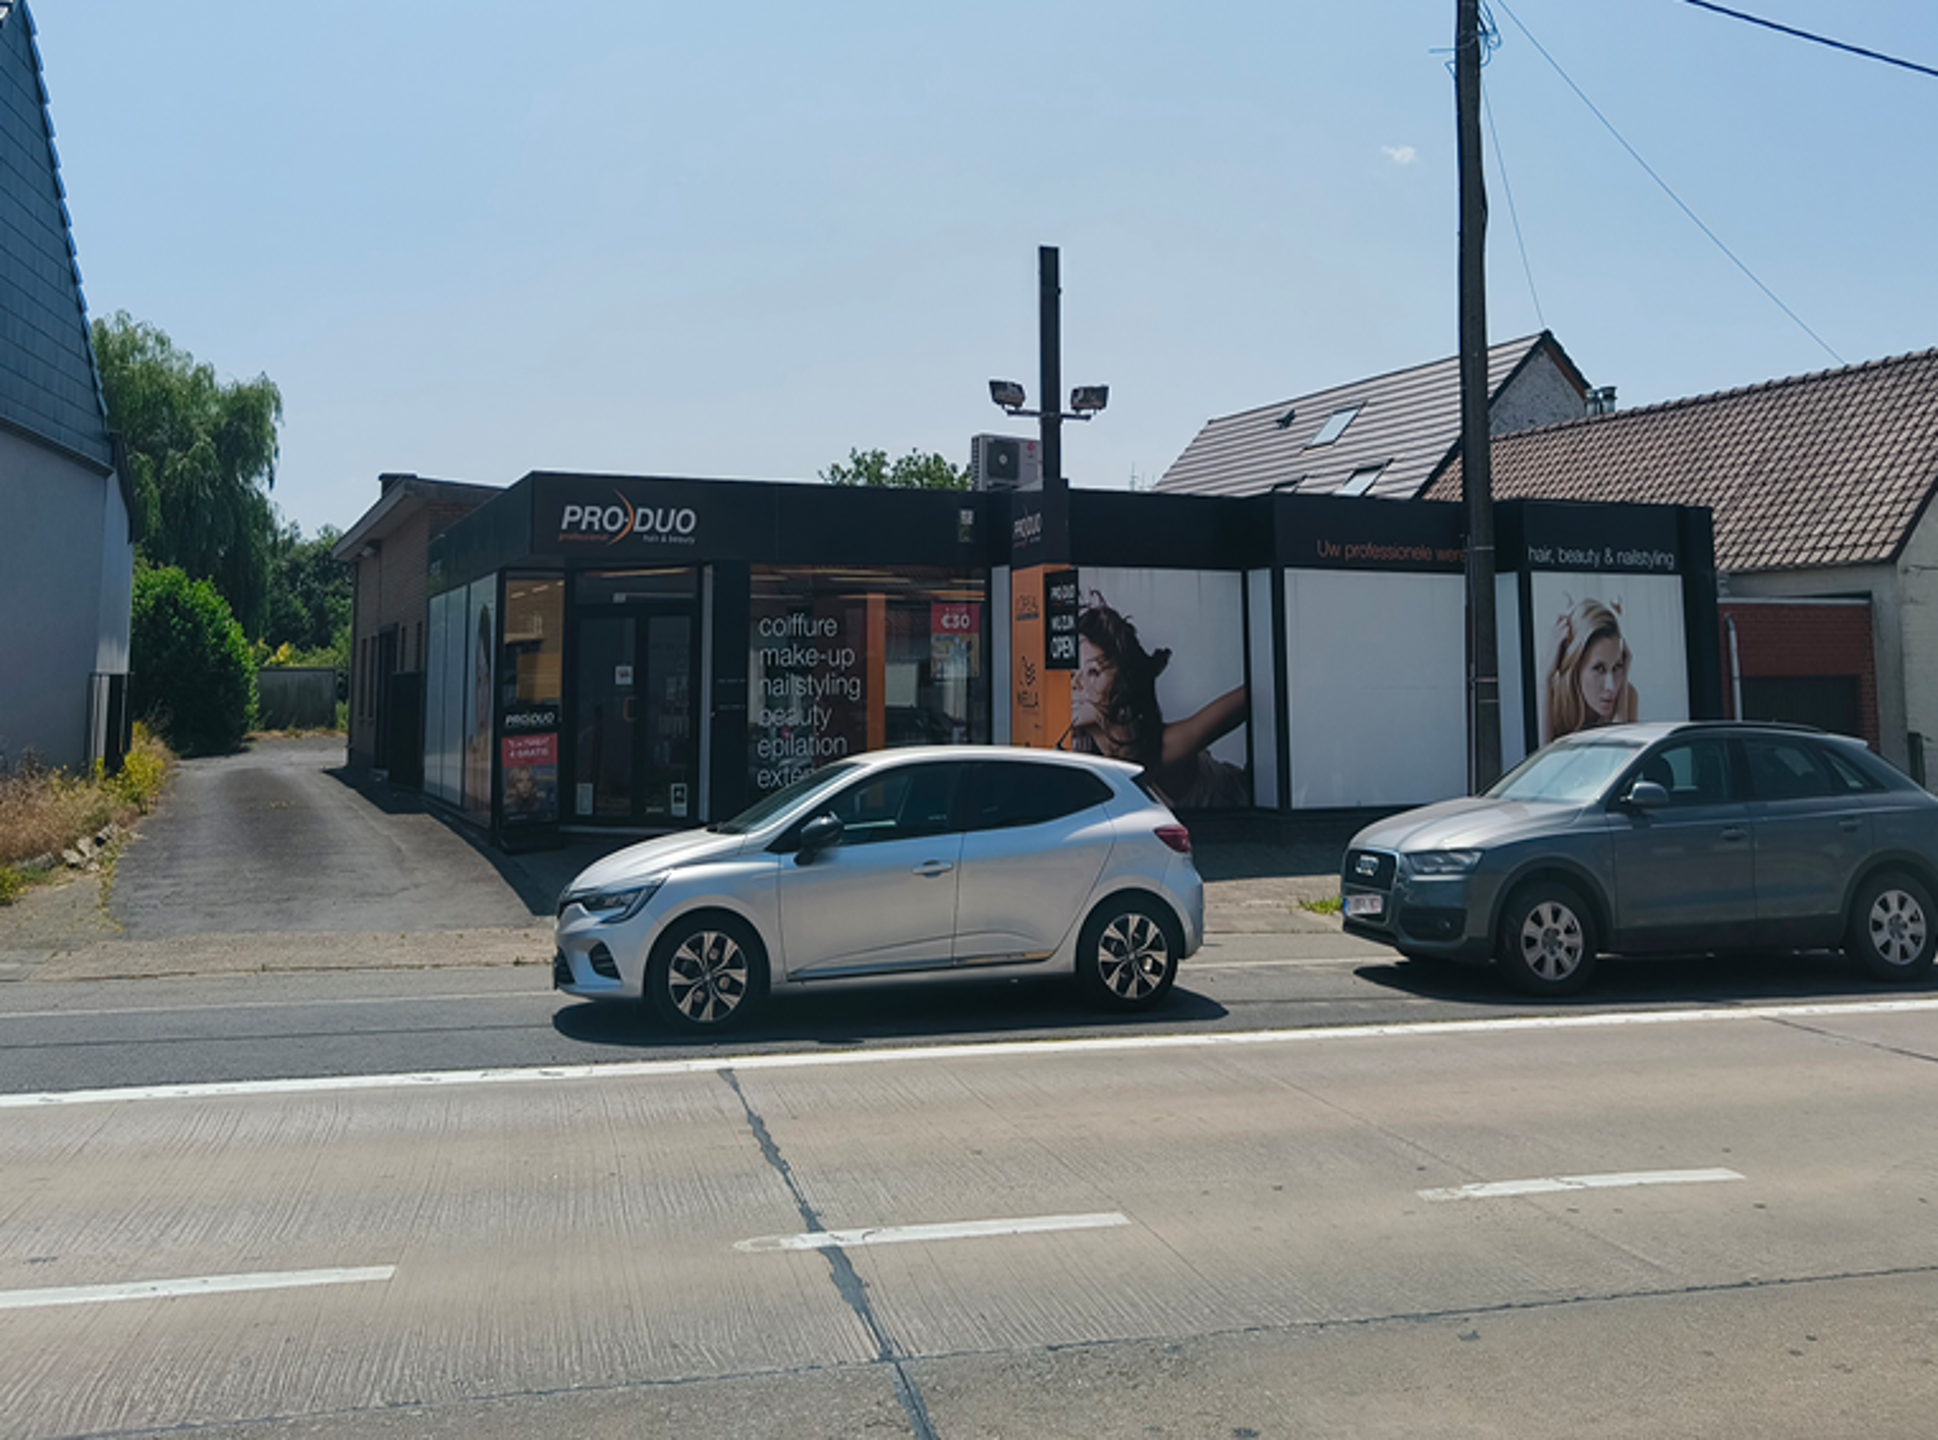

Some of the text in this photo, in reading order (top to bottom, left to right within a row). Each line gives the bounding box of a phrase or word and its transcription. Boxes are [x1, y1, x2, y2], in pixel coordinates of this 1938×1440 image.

[1316, 539, 1341, 558] Uw
[1345, 542, 1433, 561] professionele
[1527, 545, 1675, 570] hair, beauty & nailstyling
[758, 613, 838, 638] coiffure
[758, 643, 855, 670] make-up
[1050, 635, 1077, 660] OPEN
[758, 672, 861, 700] nailstyling
[757, 703, 832, 731] beauty
[757, 733, 848, 760] epilation
[757, 766, 816, 789] exten
